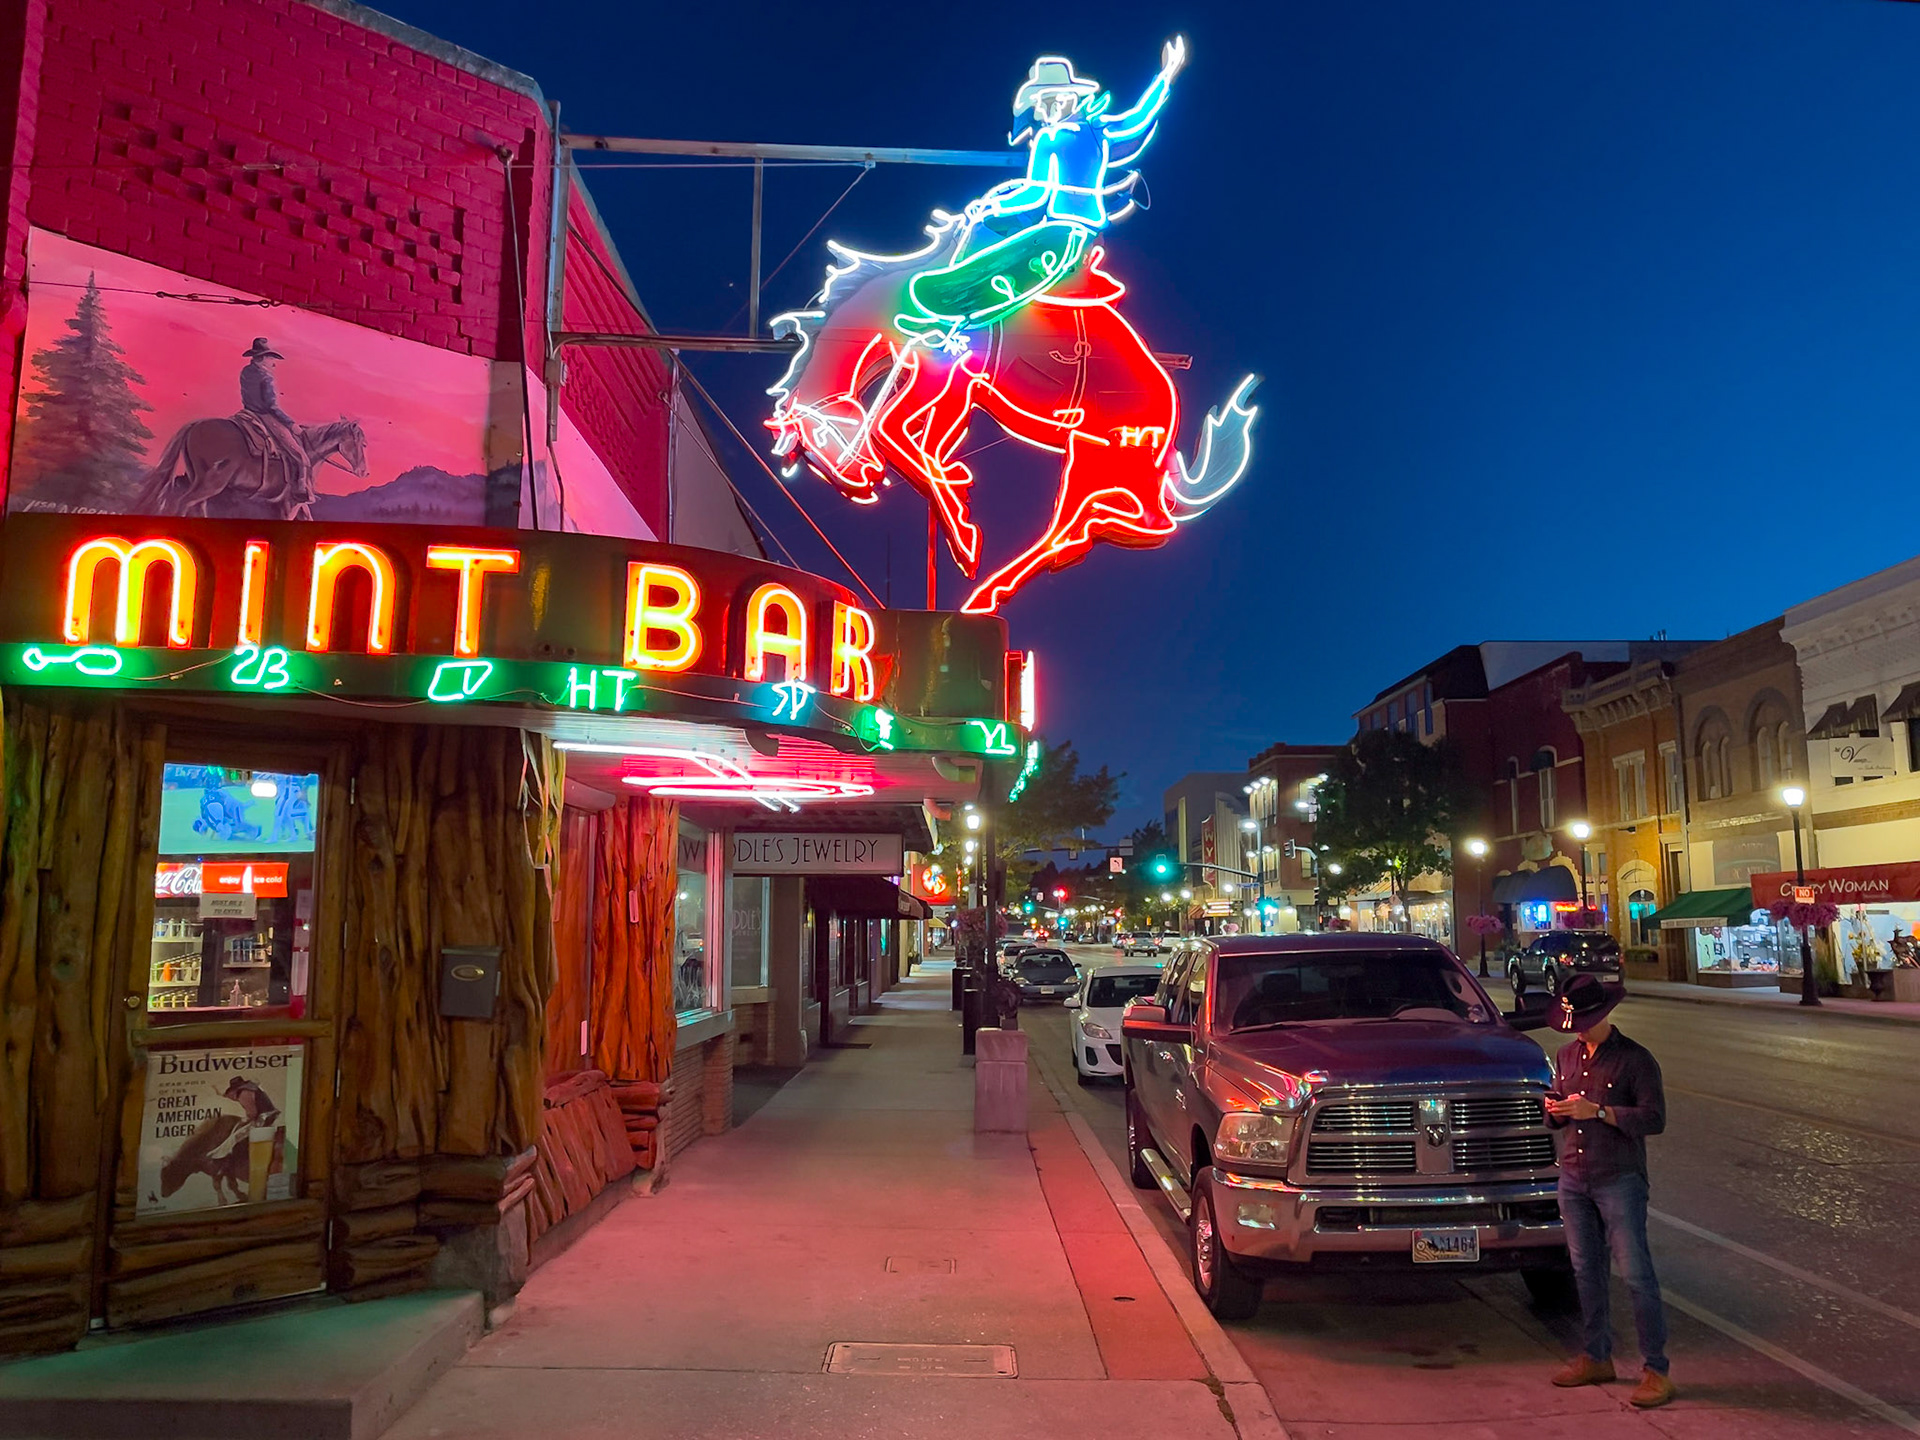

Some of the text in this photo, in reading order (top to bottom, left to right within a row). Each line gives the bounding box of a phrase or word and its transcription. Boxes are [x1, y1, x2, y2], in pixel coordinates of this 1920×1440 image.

[64, 535, 876, 702] MINT BAR
[569, 667, 637, 711] HT
[732, 837, 879, 865] DLE'S JEWELRY
[1799, 889, 1810, 897] NO
[1828, 878, 1890, 894] WOMAN
[158, 1051, 293, 1075] Budweiser
[158, 1095, 197, 1109] GREAT
[156, 1107, 222, 1124] AMERICAN
[156, 1124, 195, 1139] LAGER
